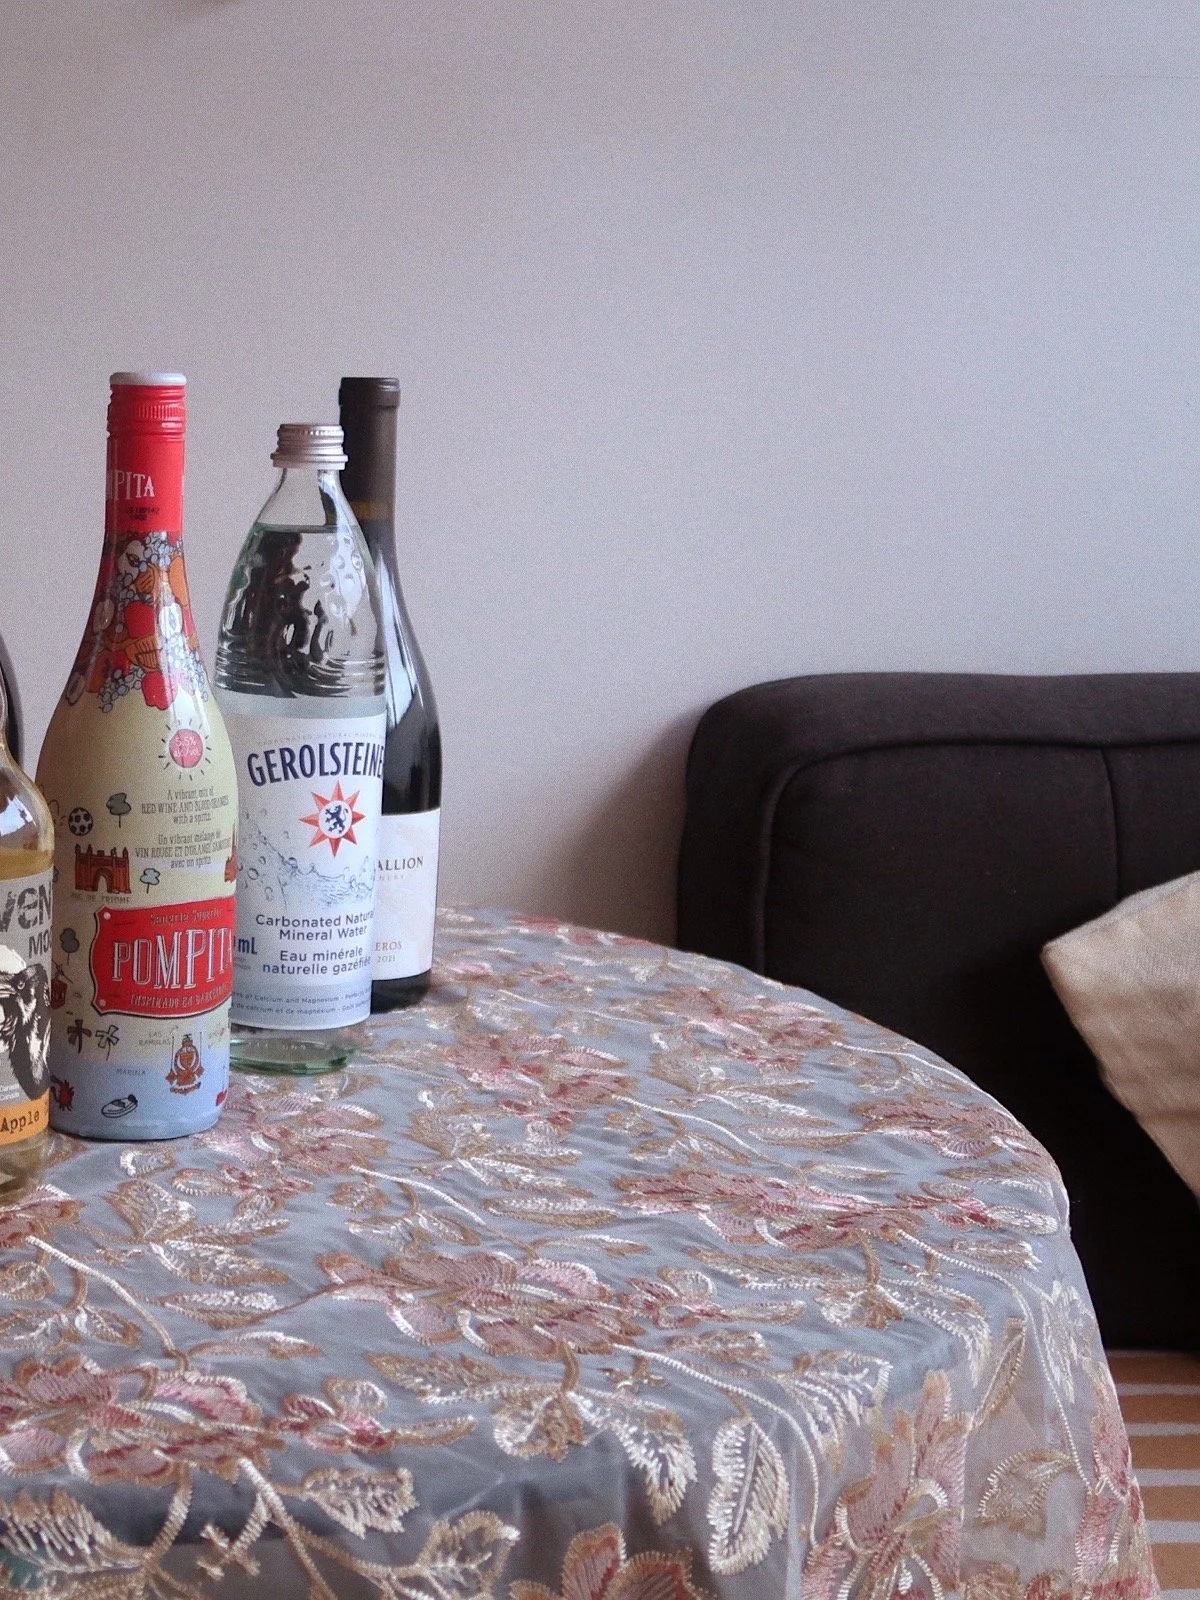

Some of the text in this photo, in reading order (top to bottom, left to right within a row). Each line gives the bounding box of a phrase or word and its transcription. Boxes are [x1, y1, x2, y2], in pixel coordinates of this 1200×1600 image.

[141, 803, 156, 814] RED
[158, 802, 178, 814] WINE
[256, 913, 341, 929] Carbonated
[279, 925, 367, 941] Mineral Water
[237, 936, 257, 956] mL
[280, 946, 363, 962] Eau minérale
[263, 963, 328, 976] naturelle
[0, 1109, 40, 1135] Apple
